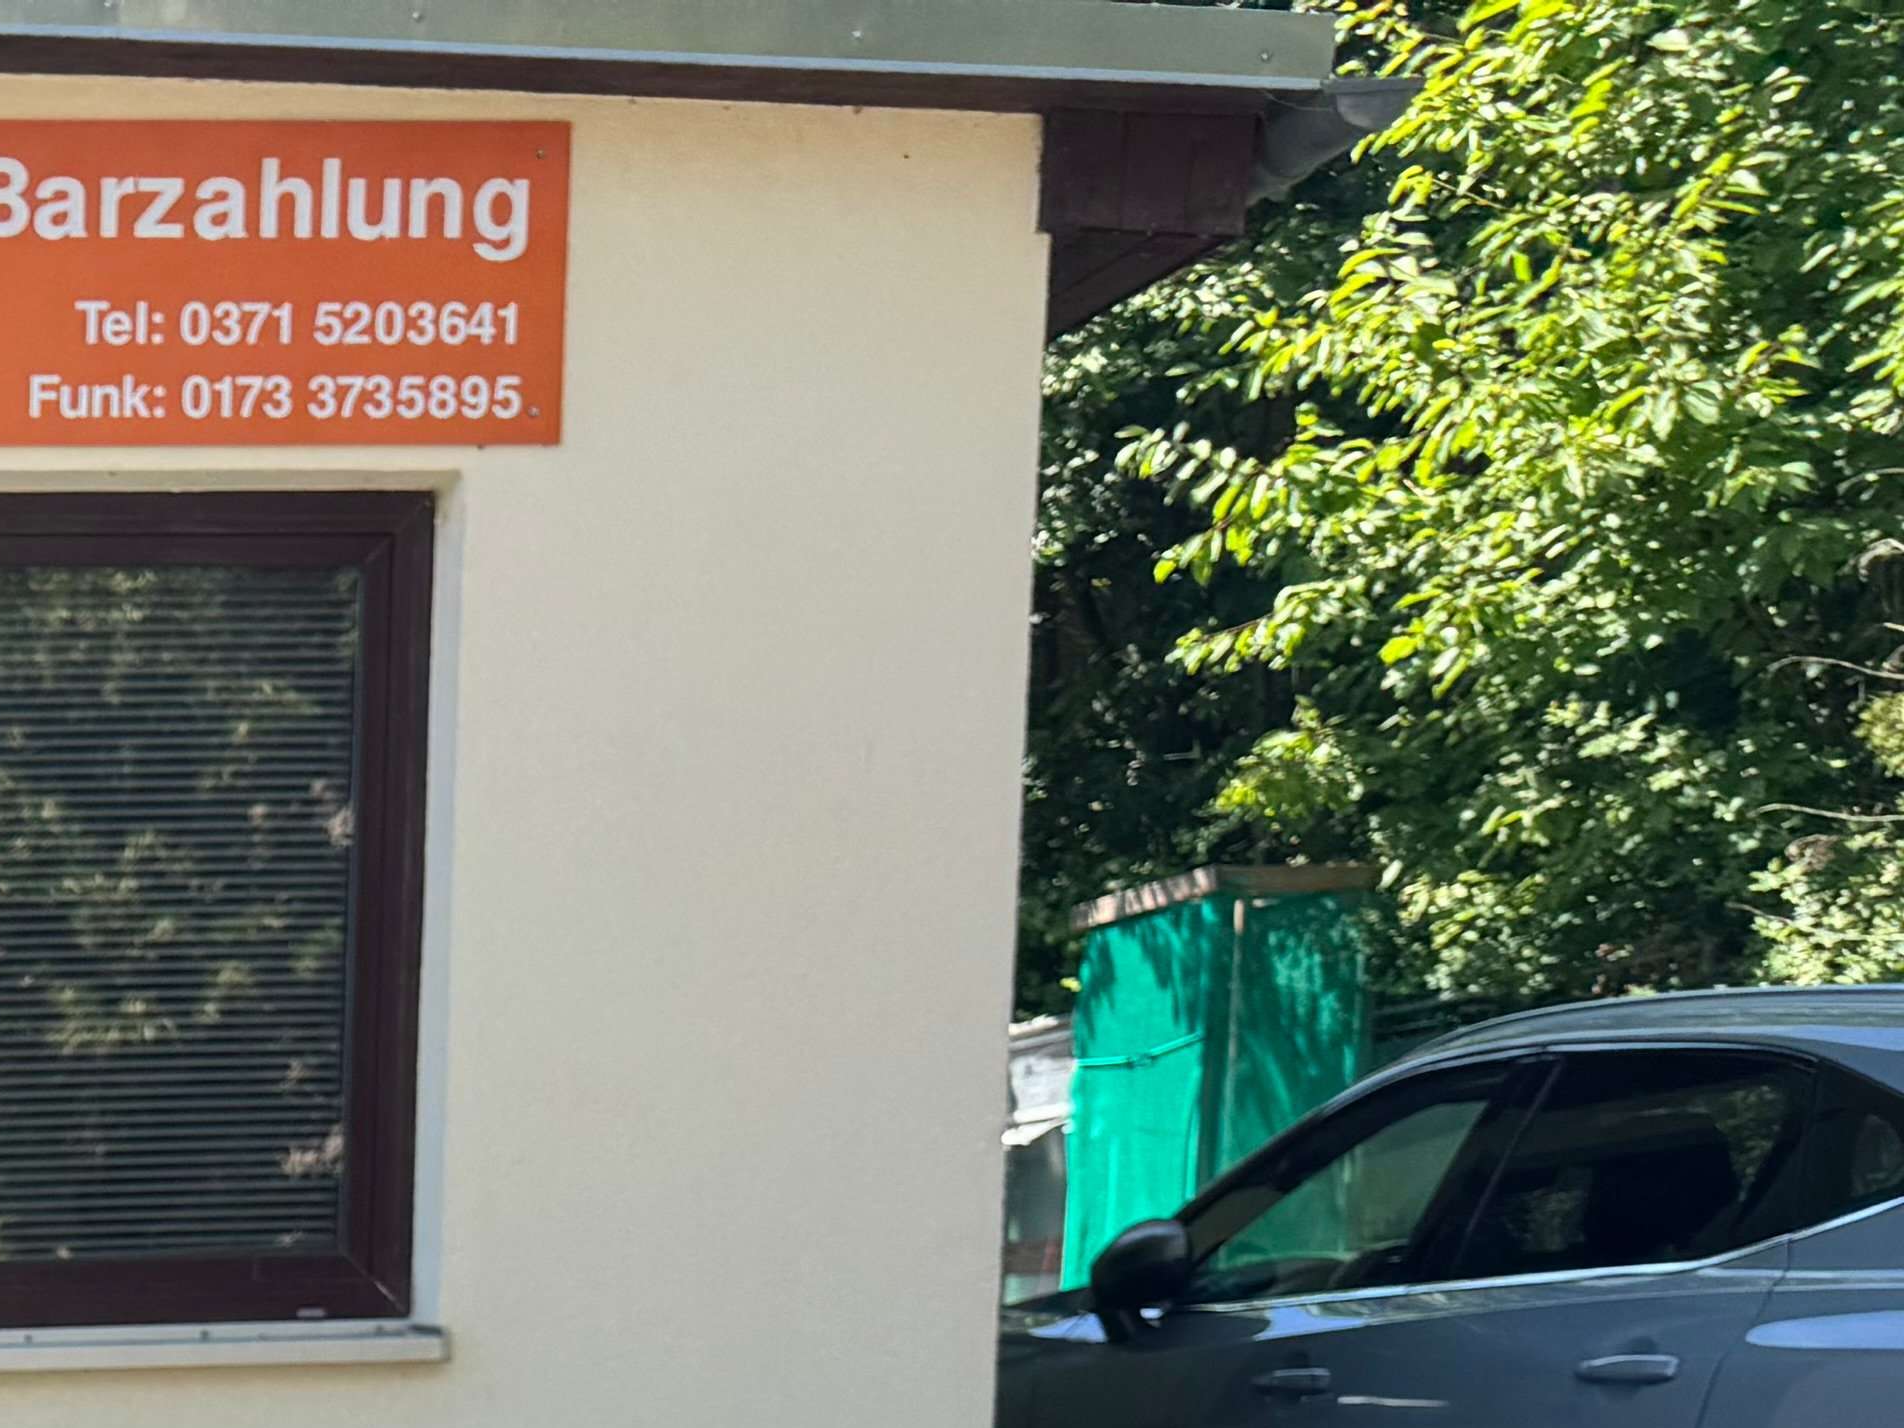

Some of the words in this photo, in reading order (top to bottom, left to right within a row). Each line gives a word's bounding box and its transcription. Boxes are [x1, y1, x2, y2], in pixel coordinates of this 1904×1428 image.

[74, 300, 164, 346] Tel:
[180, 301, 292, 346] 0371
[313, 301, 518, 346] 5203641
[29, 374, 166, 419] Funk:
[181, 374, 293, 419] 0173
[307, 374, 522, 419] 3735895
